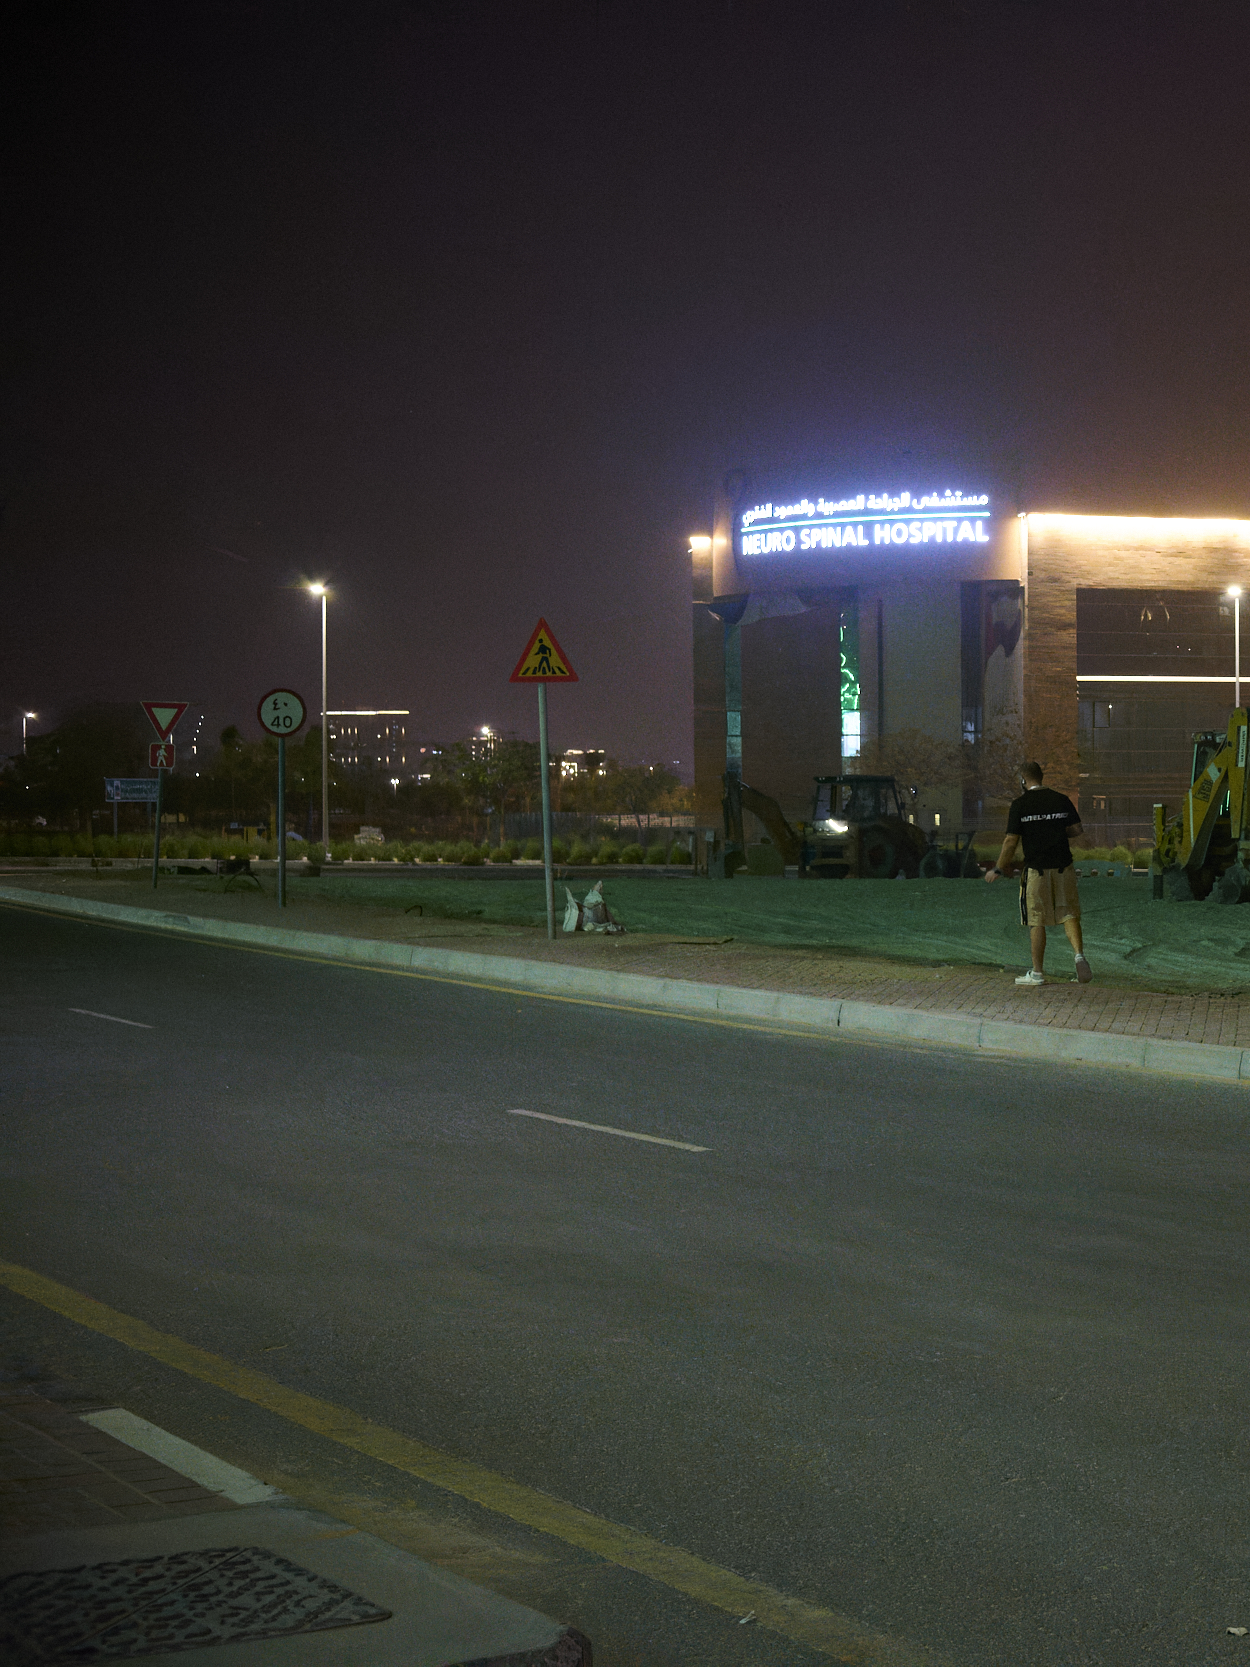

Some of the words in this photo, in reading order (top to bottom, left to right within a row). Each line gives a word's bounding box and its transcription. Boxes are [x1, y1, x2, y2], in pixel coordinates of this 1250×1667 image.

[817, 495, 864, 515] العصبية
[867, 492, 910, 512] الجراحة
[913, 489, 988, 509] مستشفى
[742, 531, 795, 555] NEURO
[801, 525, 869, 550] SPINAL
[875, 521, 989, 544] HOSPITAL
[273, 699, 288, 710] ٤٠
[271, 716, 292, 728] 40
